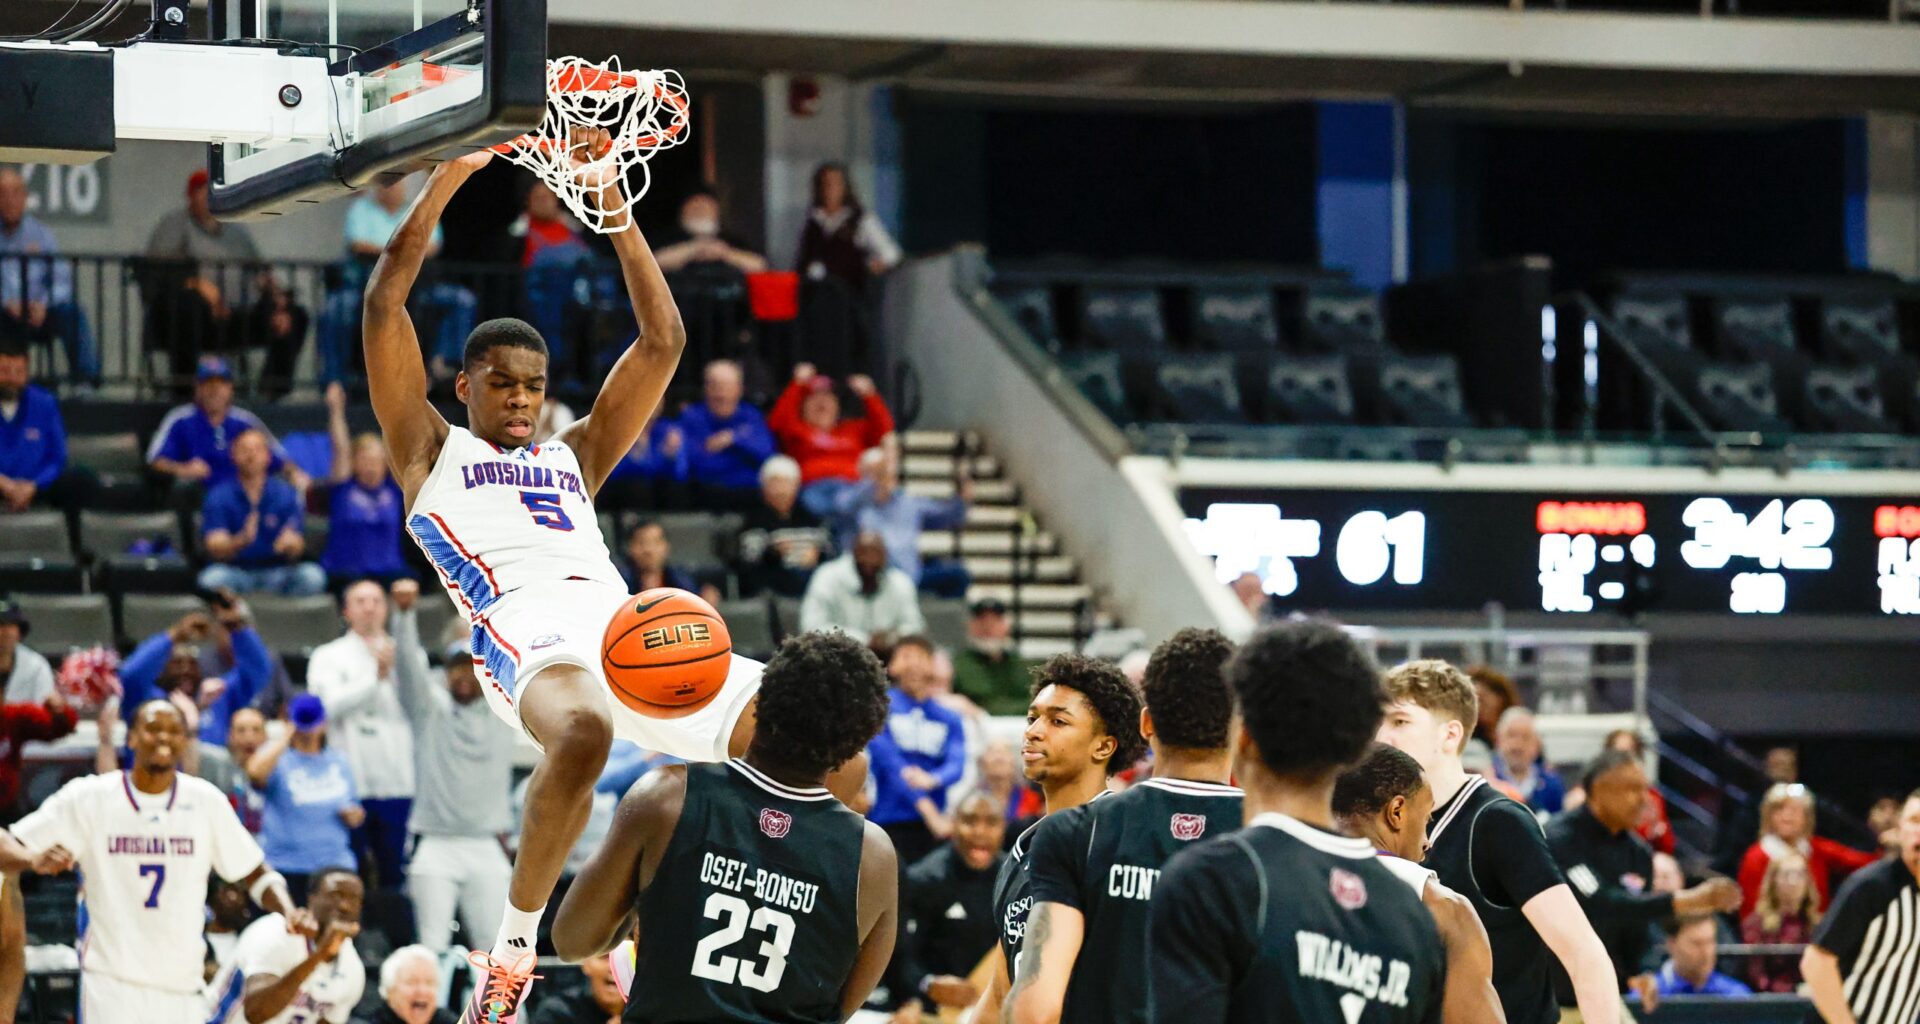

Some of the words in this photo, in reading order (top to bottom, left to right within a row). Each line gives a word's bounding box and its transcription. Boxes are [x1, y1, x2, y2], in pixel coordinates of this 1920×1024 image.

[461, 461, 556, 490] LOUISIANA
[518, 490, 575, 531] 5
[1536, 501, 1647, 536] BONUS
[1336, 510, 1426, 585] 61
[641, 623, 711, 650] ELITE
[138, 863, 167, 909] 7
[700, 851, 820, 915] OSEI-BONSU
[1108, 863, 1162, 901] CUN
[690, 891, 797, 994] 23
